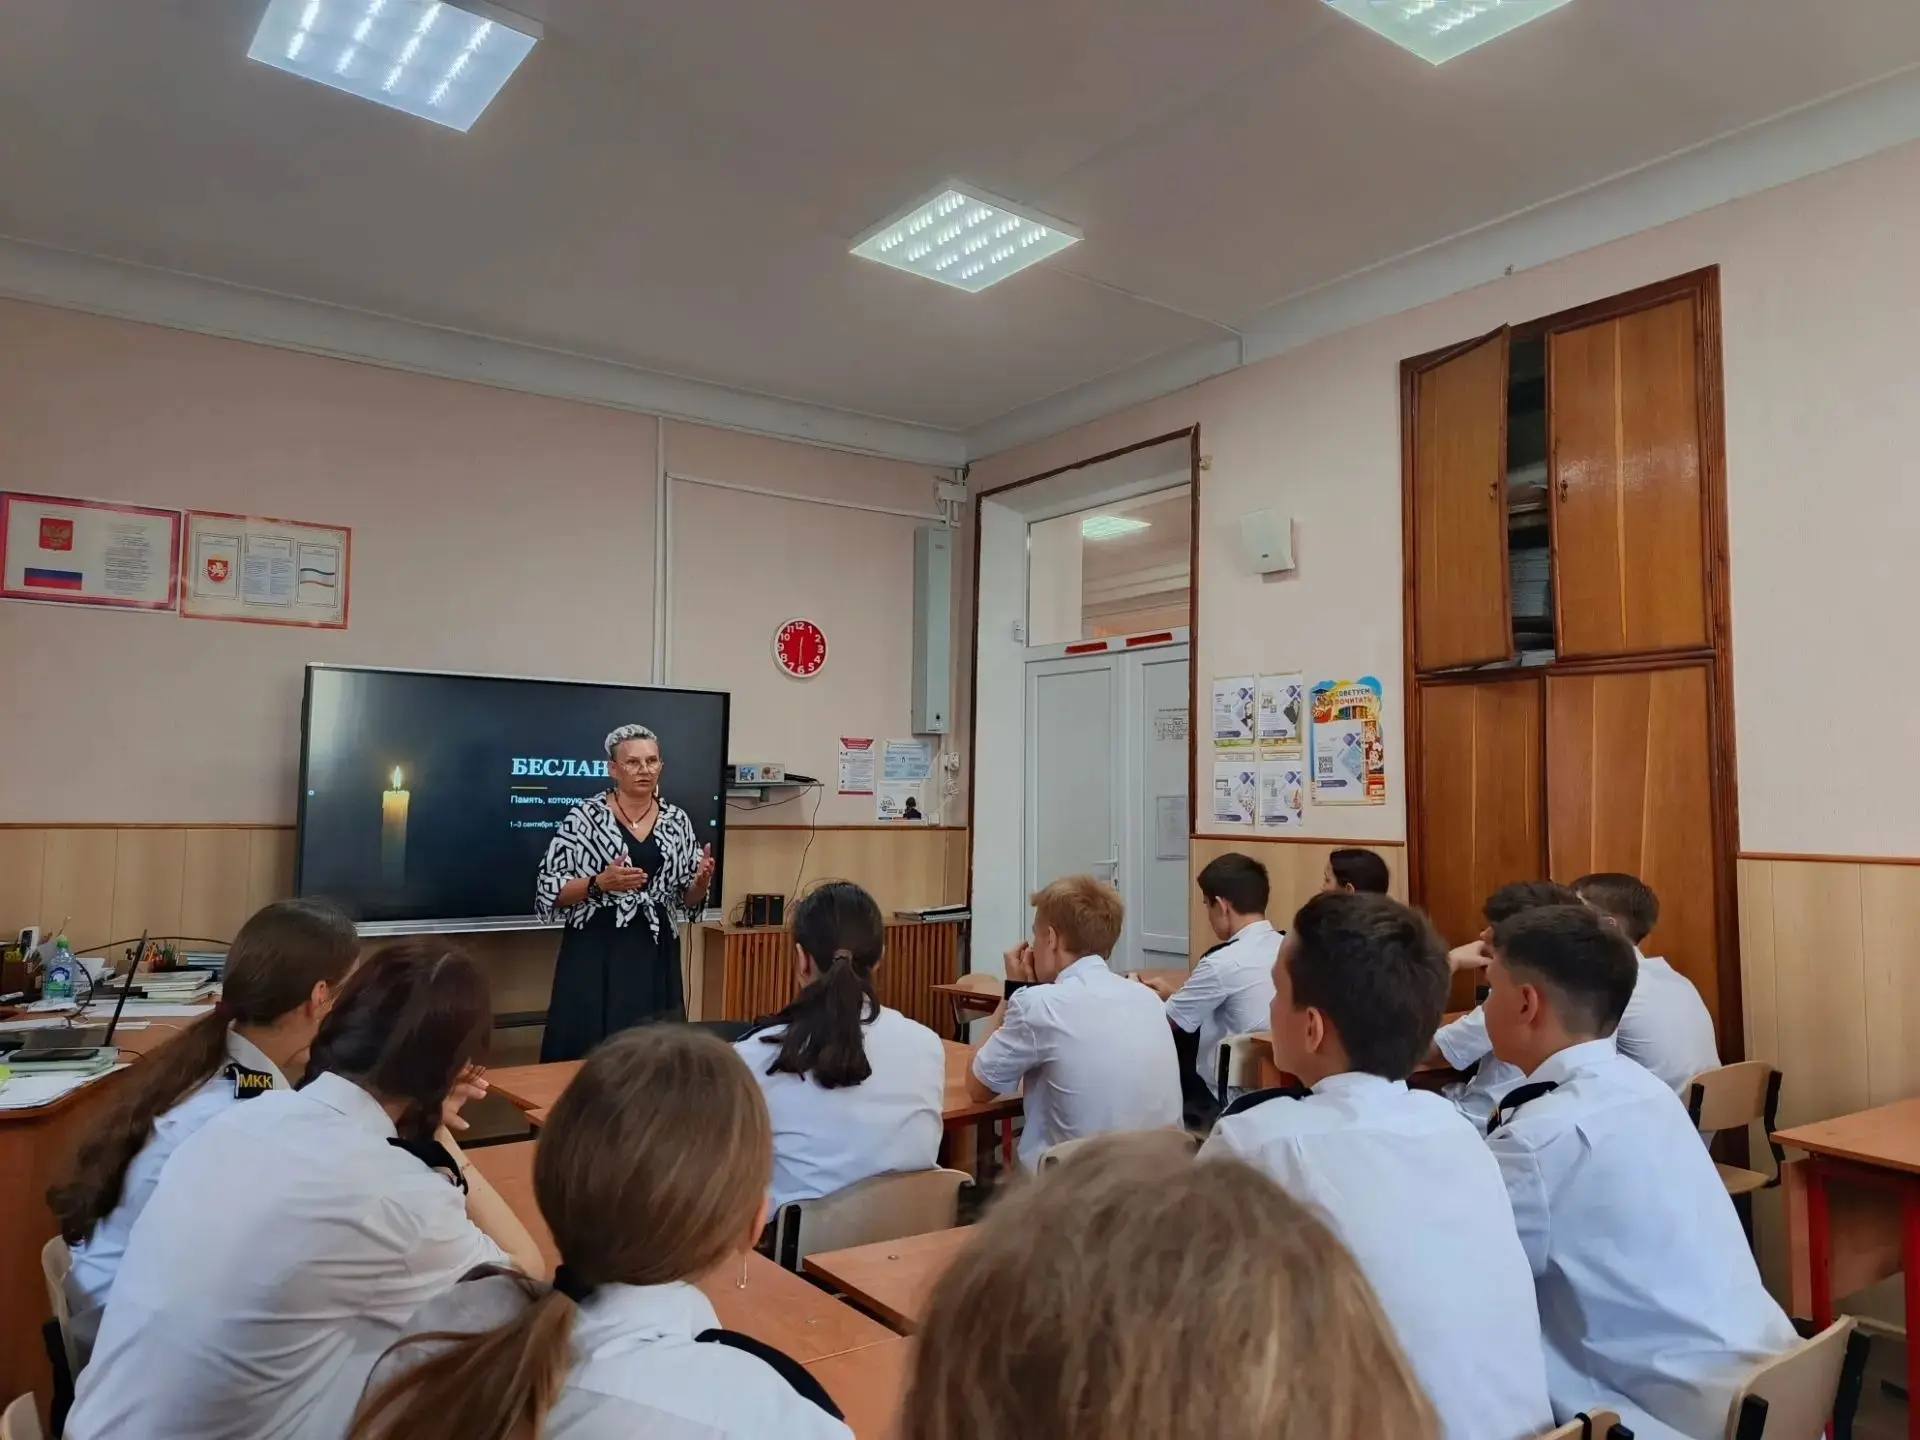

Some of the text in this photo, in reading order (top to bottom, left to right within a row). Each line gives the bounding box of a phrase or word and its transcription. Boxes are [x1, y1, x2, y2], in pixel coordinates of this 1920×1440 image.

[787, 625, 794, 633] 11
[795, 622, 805, 630] 12
[808, 625, 813, 634] 1
[781, 633, 790, 641] 10
[815, 634, 821, 643] 2
[777, 642, 784, 651] 9
[817, 645, 824, 654] 3
[780, 653, 788, 662] 8
[814, 655, 821, 664] 4
[787, 662, 794, 671] 7
[797, 665, 804, 674] 6
[808, 662, 815, 671] 5
[511, 758, 610, 777] БЕСЛАН
[510, 795, 546, 804] Память,
[522, 820, 553, 829] сентября
[239, 1074, 272, 1088] МКК
